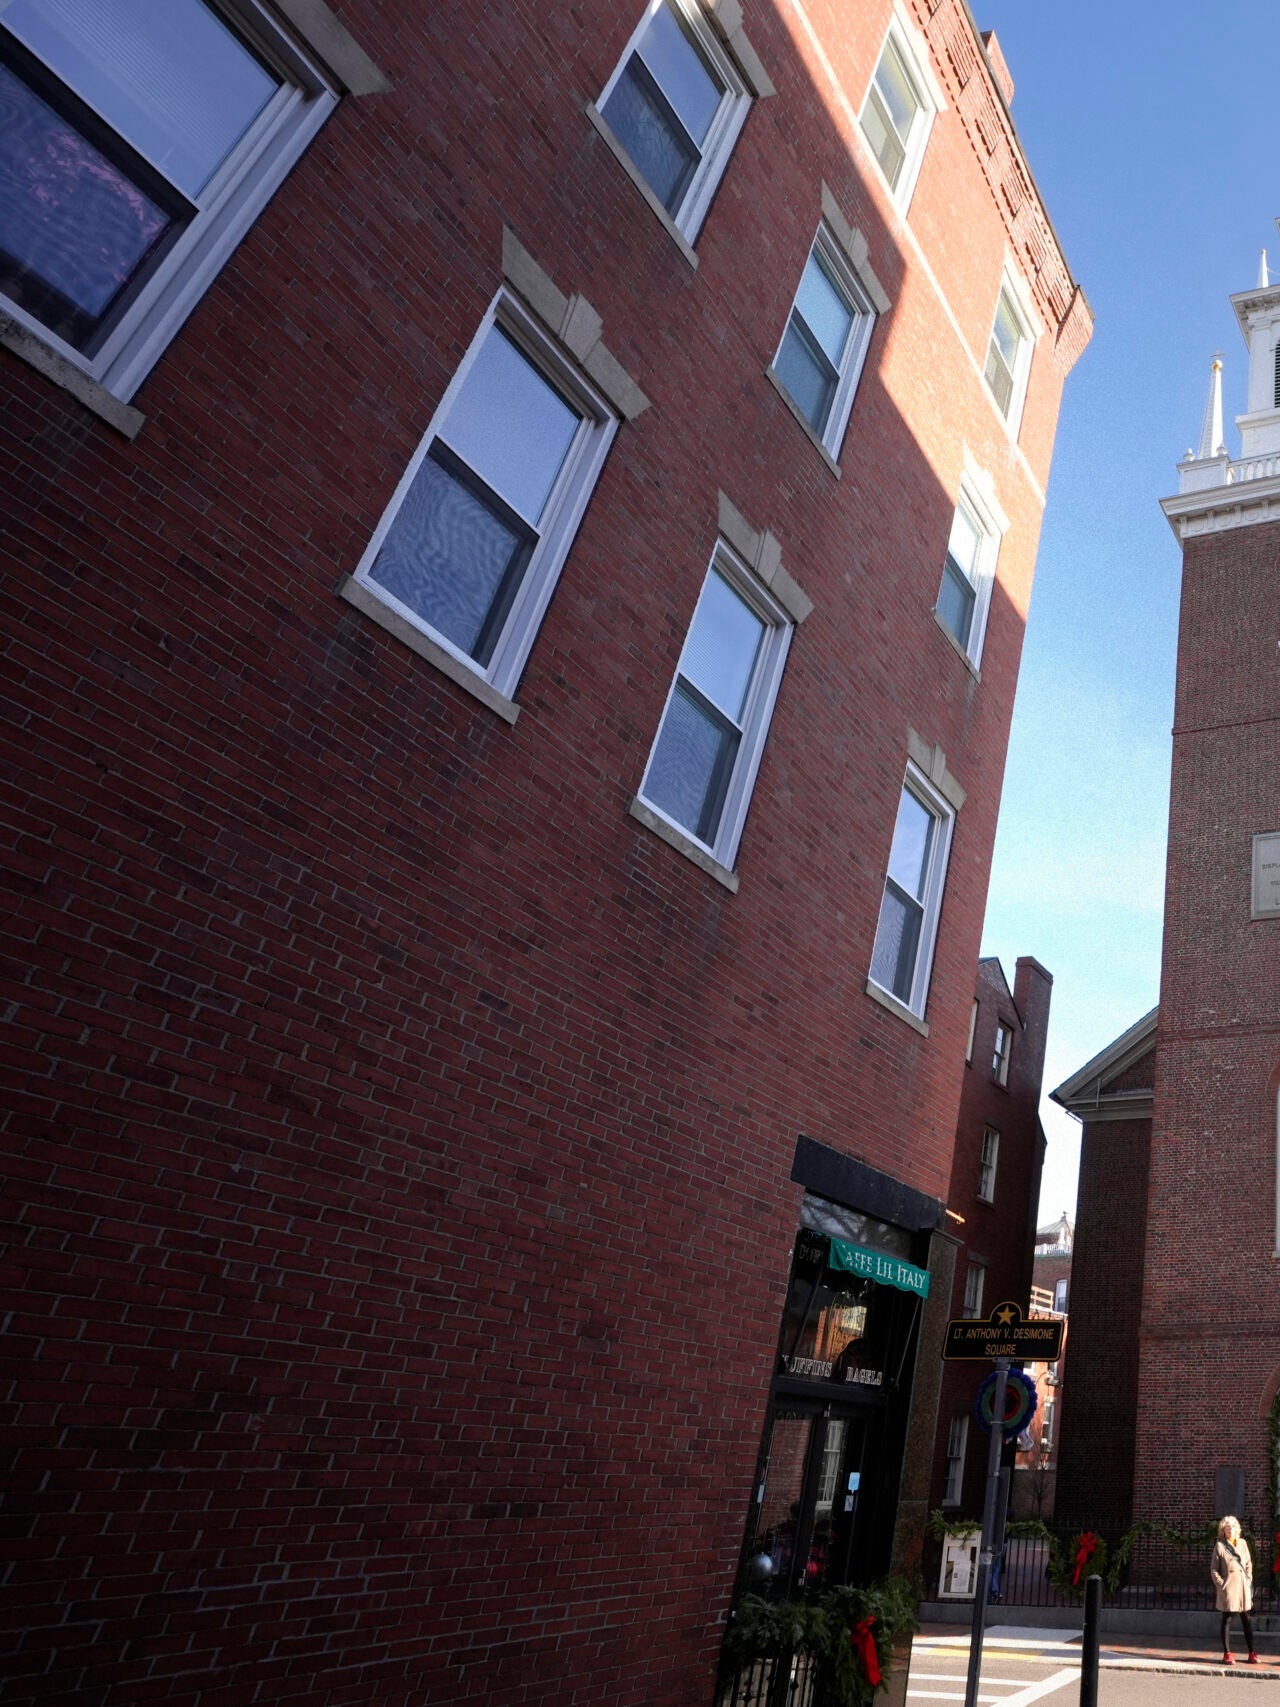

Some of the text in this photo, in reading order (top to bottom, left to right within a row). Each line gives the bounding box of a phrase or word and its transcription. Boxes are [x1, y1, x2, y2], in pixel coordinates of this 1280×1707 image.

[842, 1244, 926, 1289] AFFE LIL ITALY
[953, 1328, 1055, 1340] LT. ANTHONY V. DESIMONE
[985, 1344, 1017, 1355] SQUARE
[845, 1366, 883, 1386] BAGELS
